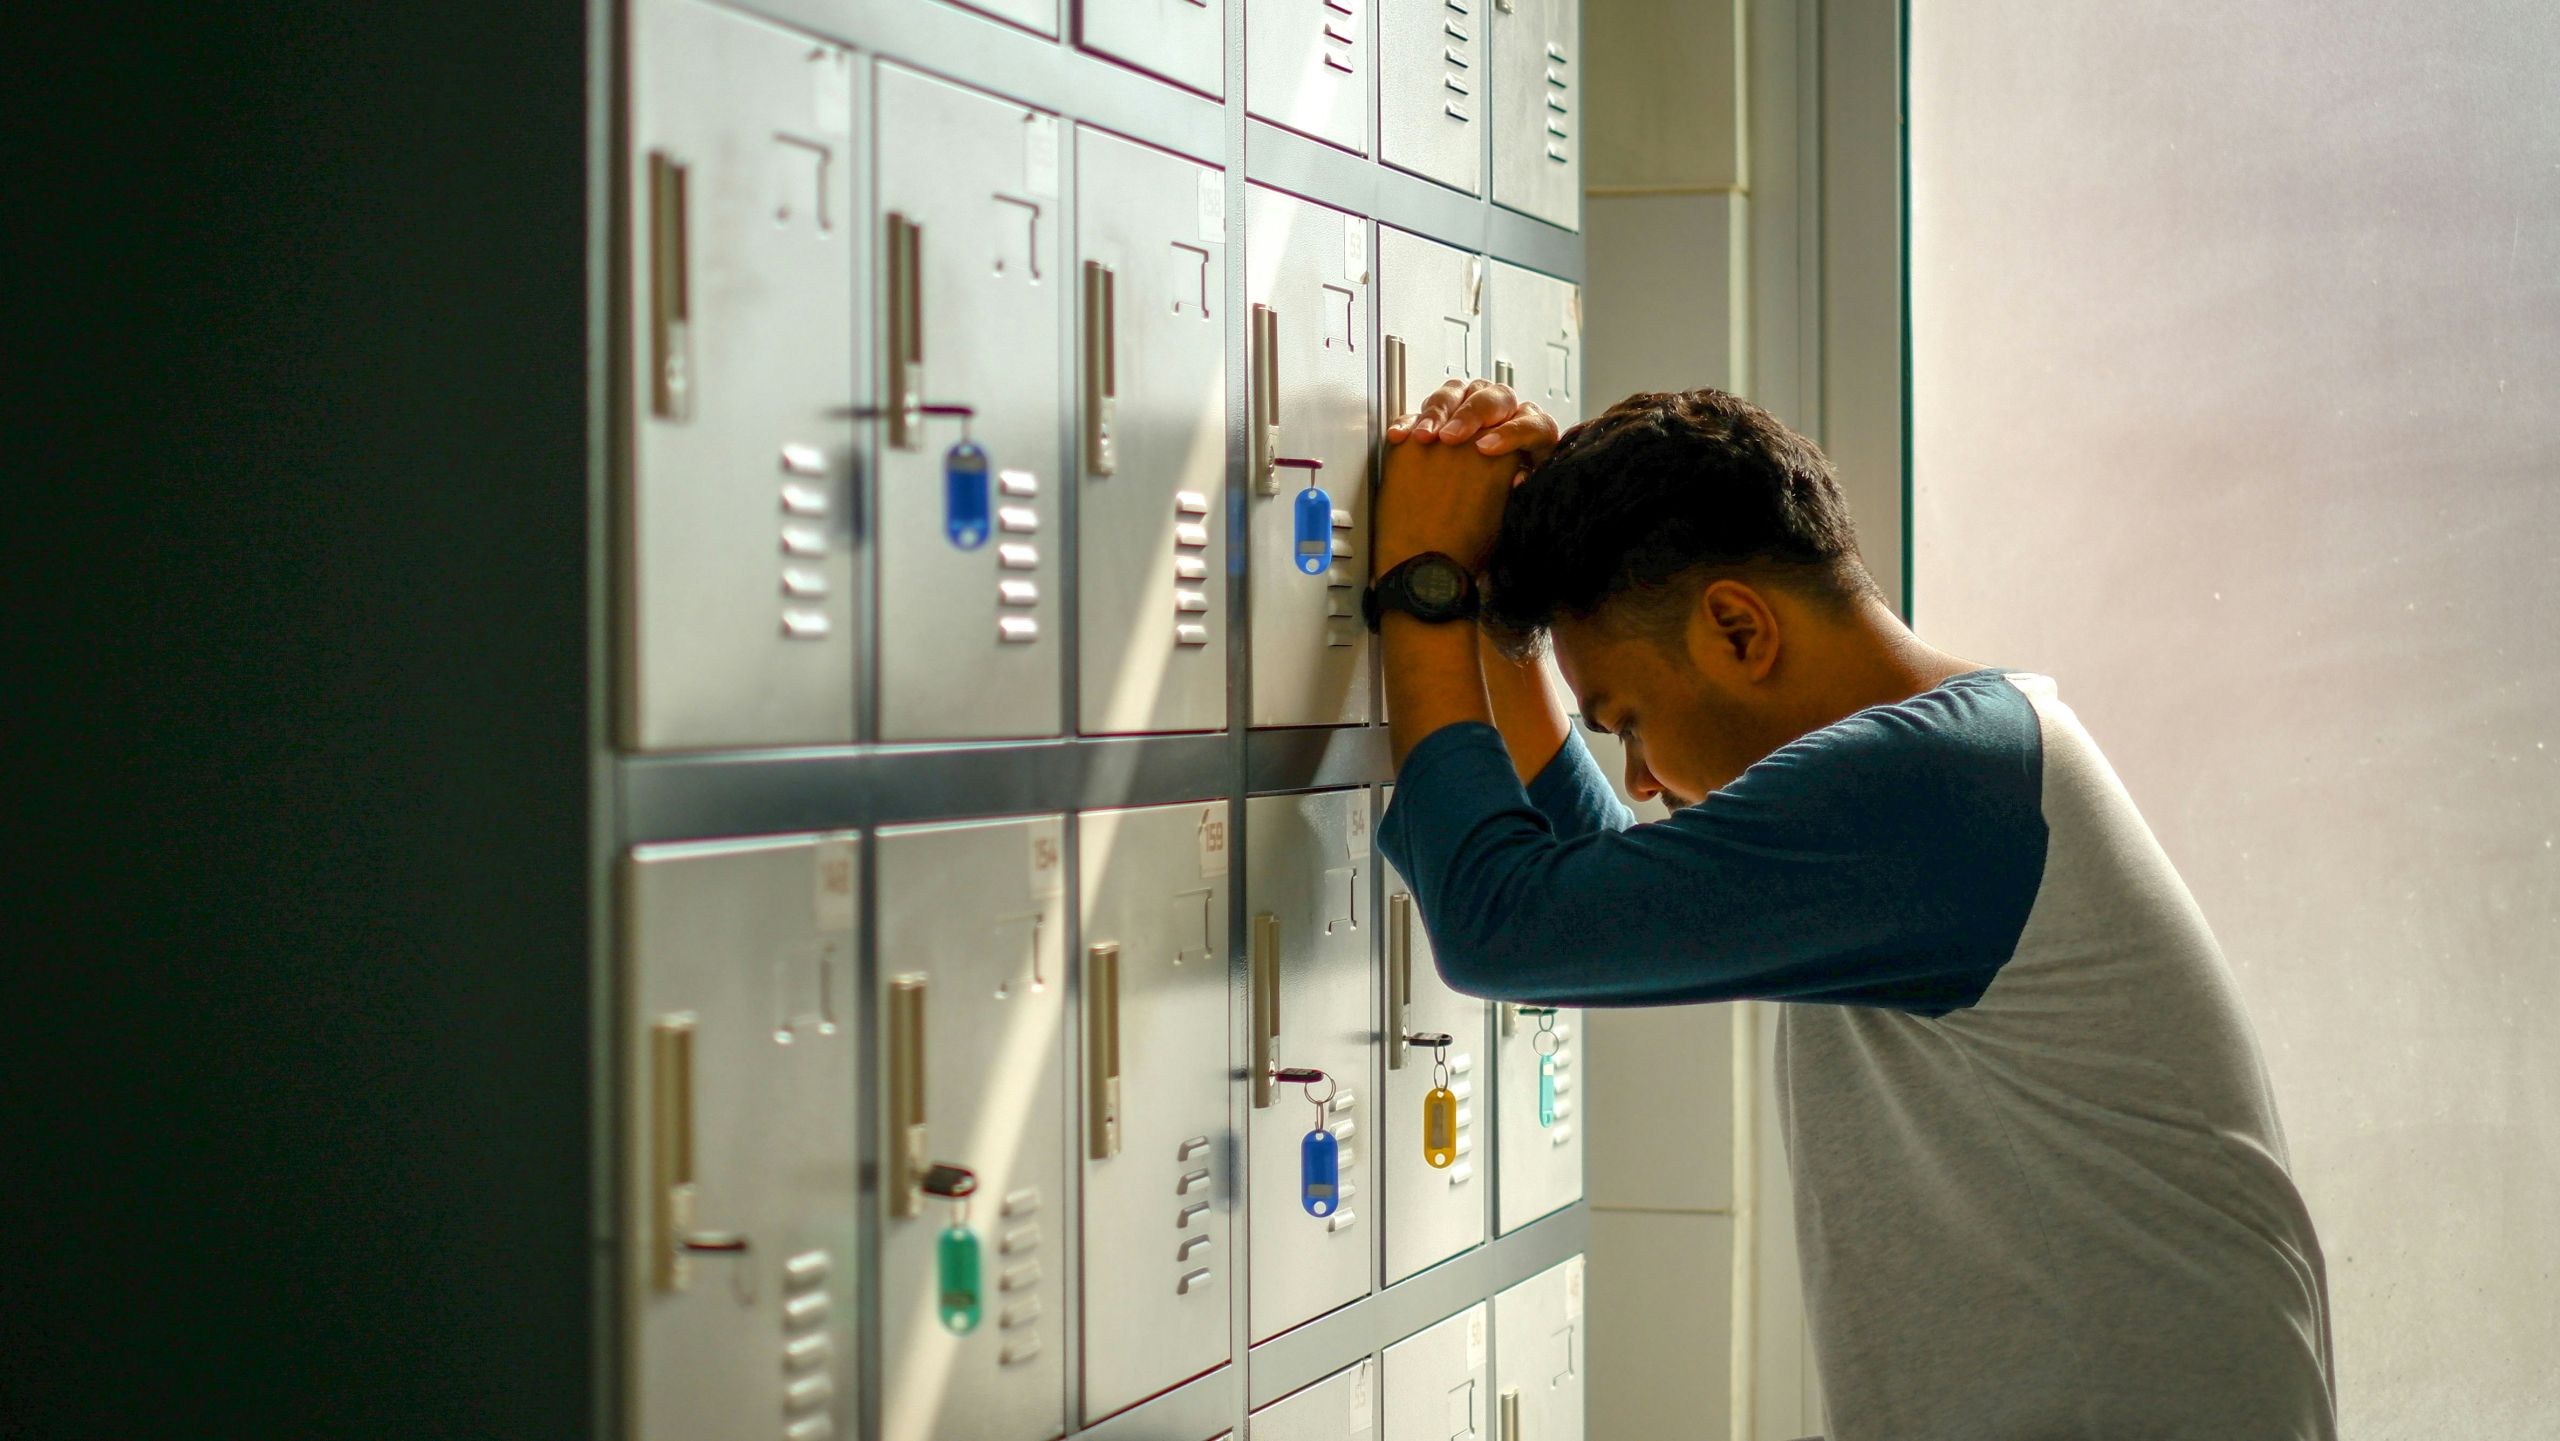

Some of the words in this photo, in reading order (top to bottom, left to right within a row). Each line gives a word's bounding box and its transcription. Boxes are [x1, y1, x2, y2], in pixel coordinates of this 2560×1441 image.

[1350, 232, 1362, 260] 53
[1205, 821, 1223, 852] 159
[1352, 808, 1365, 836] 54
[1034, 836, 1058, 871] 154
